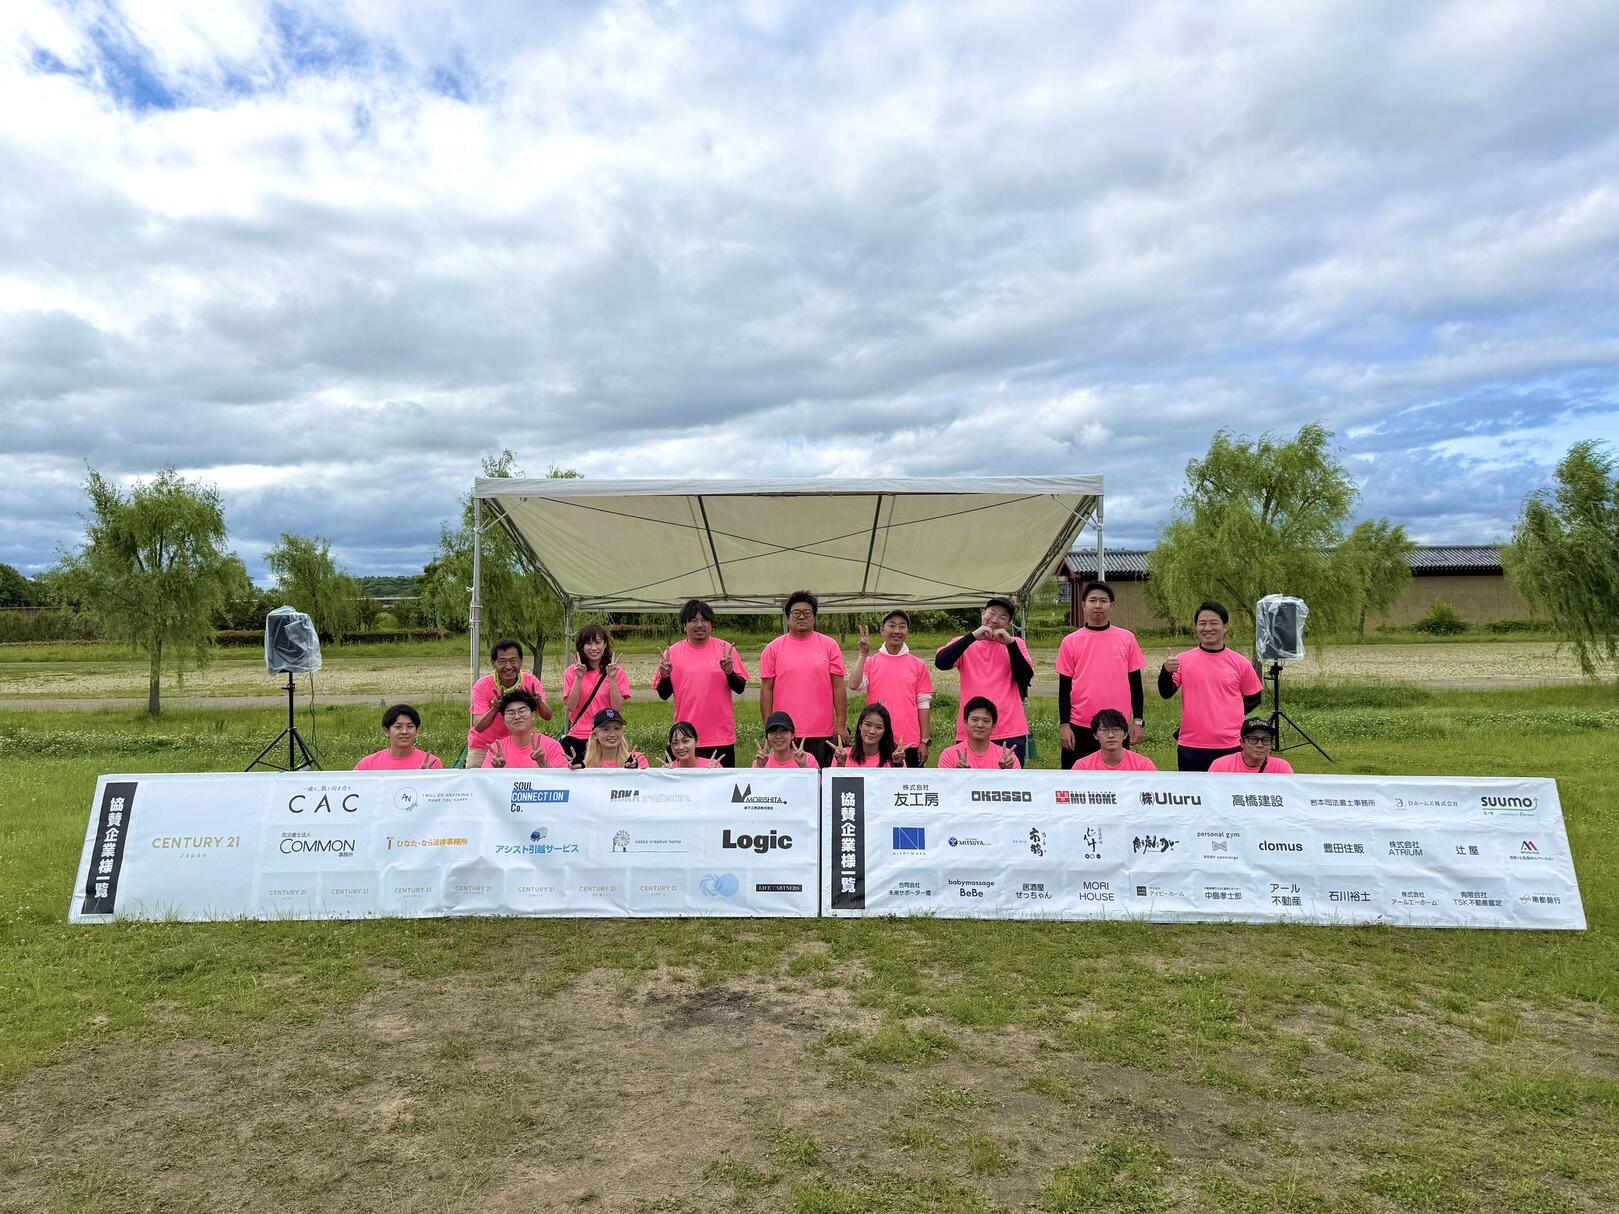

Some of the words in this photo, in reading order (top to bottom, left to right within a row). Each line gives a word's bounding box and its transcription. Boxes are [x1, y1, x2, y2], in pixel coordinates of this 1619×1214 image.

[513, 782, 533, 791] SOUL
[511, 792, 564, 802] CONNECTION
[894, 792, 939, 807] 友工房
[1231, 794, 1284, 807] 高橋建設
[289, 794, 360, 813] CAC
[1310, 799, 1376, 807] 岩本司法書士事務所
[511, 804, 523, 813] Co.
[152, 837, 223, 849] CENTURY
[227, 836, 240, 848] 21
[280, 838, 355, 854] COMMON
[722, 829, 793, 854] Logic
[841, 792, 856, 893] 協賛企業様一覧
[1389, 841, 1420, 849] 株式会社
[94, 797, 125, 898] 協賛企業様一覧
[496, 844, 579, 854] アシスト引越サービス
[1323, 843, 1365, 854] 豊田住販
[948, 879, 995, 888] babymassage
[1022, 883, 1045, 891] 居酒屋
[1083, 881, 1109, 890] MORI
[1270, 883, 1301, 893] アール
[959, 888, 984, 898] BeBe
[1016, 891, 1053, 899] せっちゃん
[1079, 892, 1115, 901] HOUSE
[1329, 891, 1371, 902] 石川裕士
[1271, 896, 1302, 907] 不動産
[1532, 896, 1561, 904] 南都銀行
